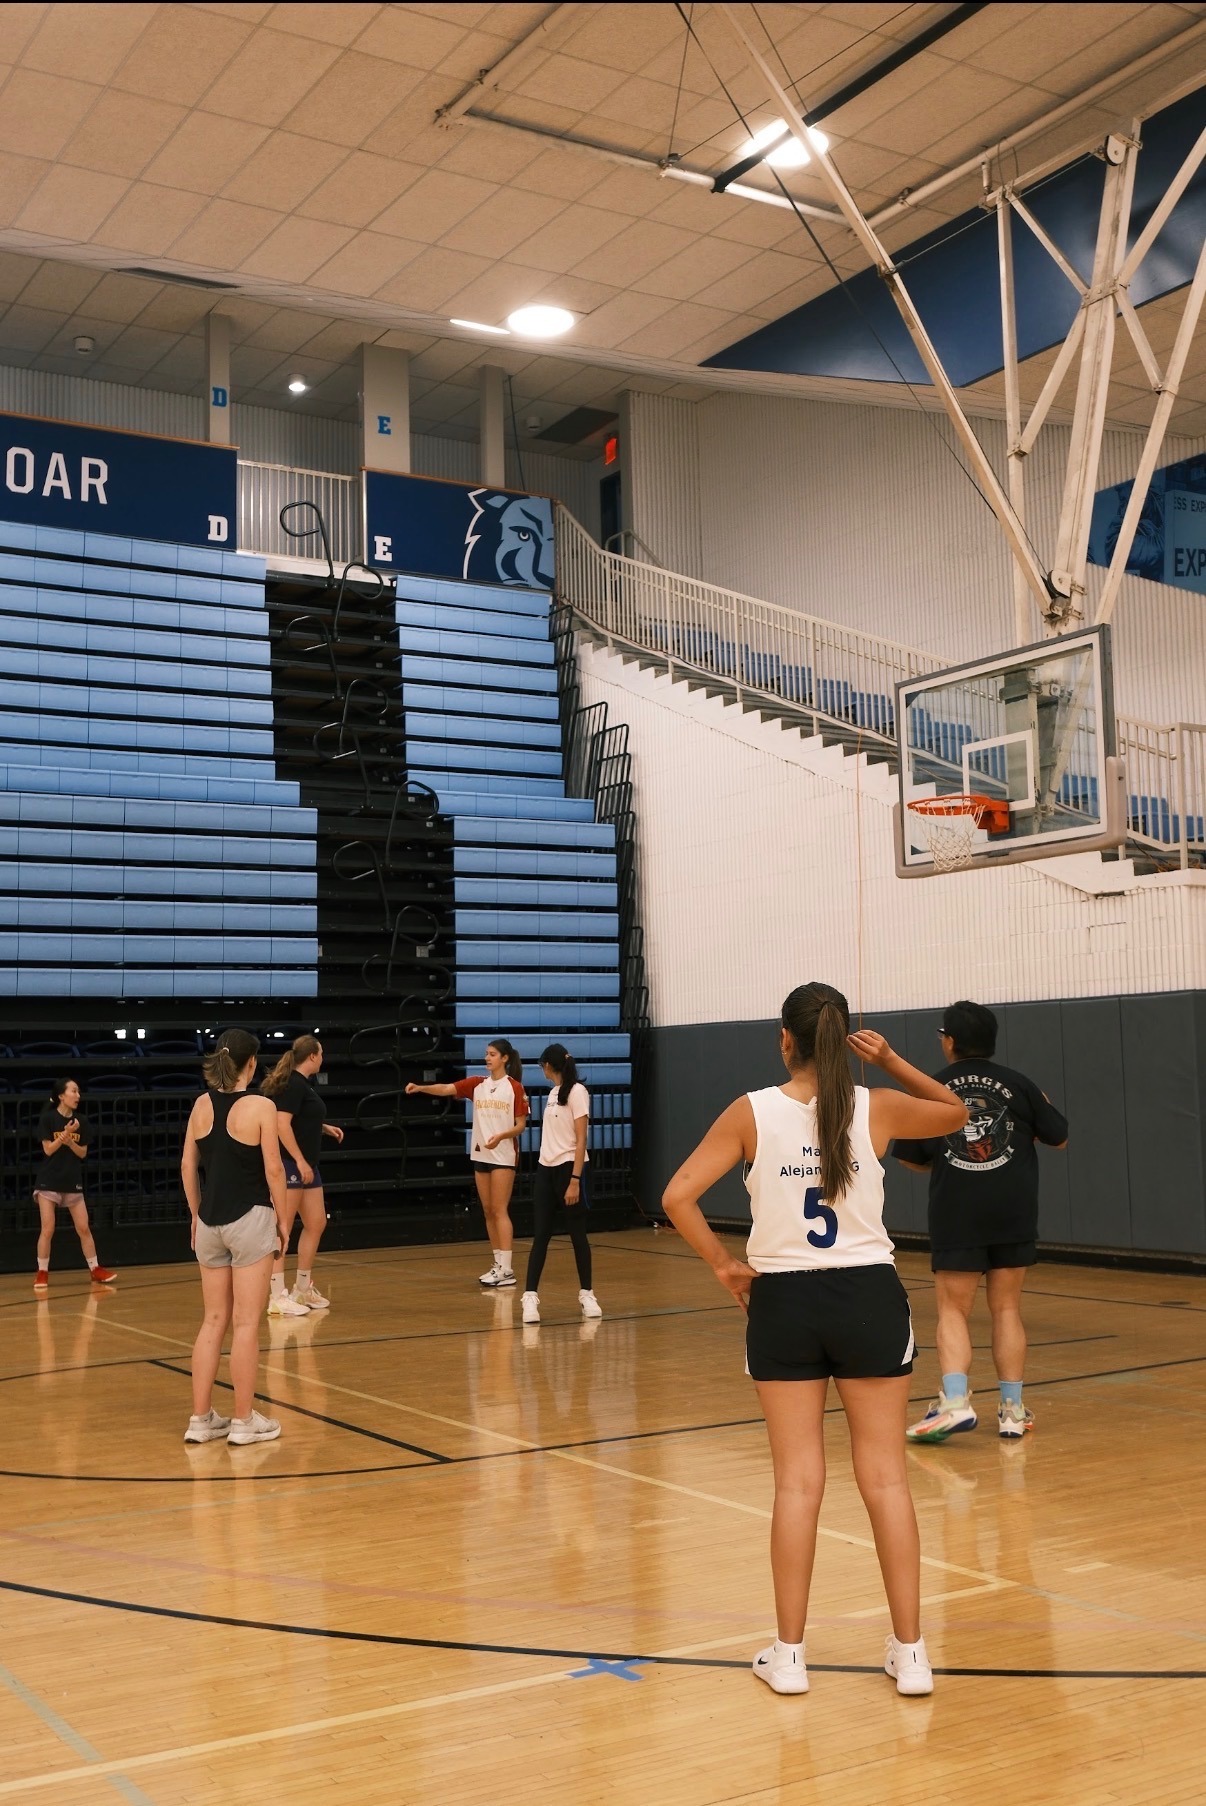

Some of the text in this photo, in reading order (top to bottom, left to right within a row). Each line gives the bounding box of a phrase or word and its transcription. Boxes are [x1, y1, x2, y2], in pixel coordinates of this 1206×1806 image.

[211, 387, 228, 407] D
[377, 415, 392, 436] E
[5, 446, 110, 505] OAR
[207, 514, 229, 543] D
[373, 534, 393, 562] E
[945, 1075, 1013, 1099] TURGIS
[802, 1146, 821, 1157] Ma
[779, 1164, 822, 1178] Alejan
[804, 1187, 838, 1249] 5
